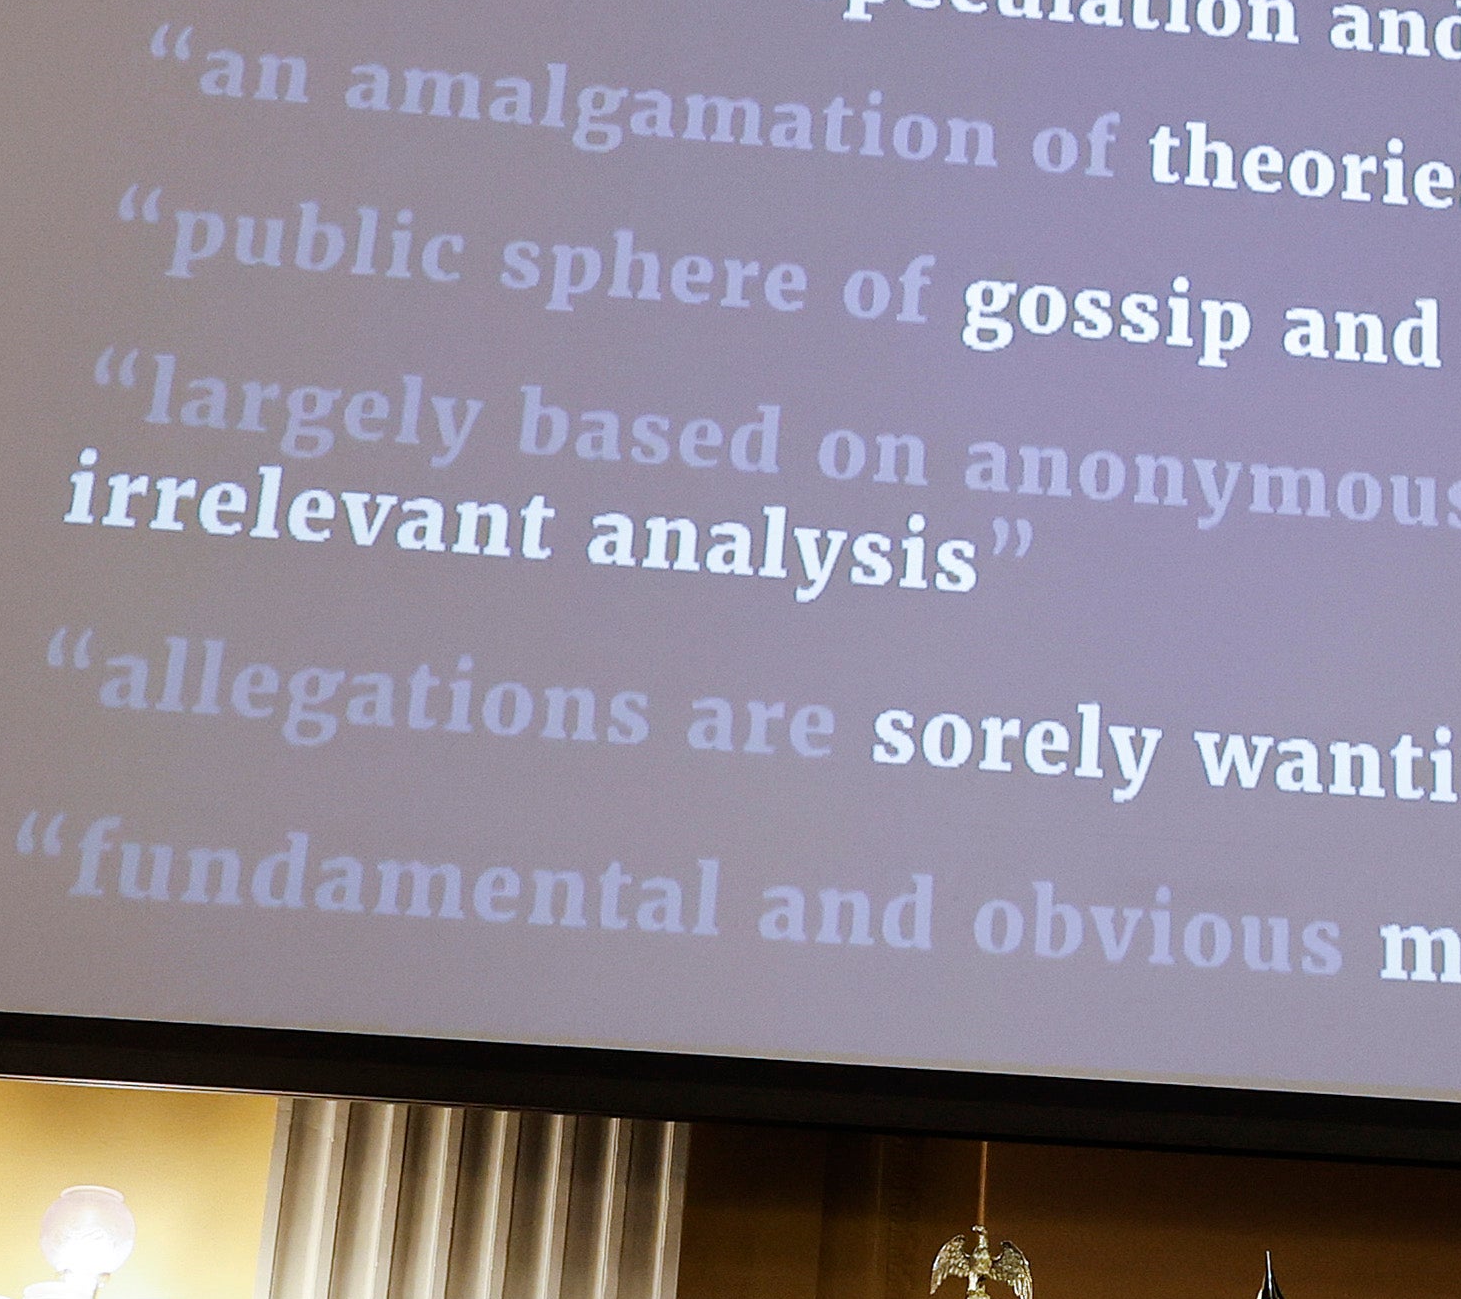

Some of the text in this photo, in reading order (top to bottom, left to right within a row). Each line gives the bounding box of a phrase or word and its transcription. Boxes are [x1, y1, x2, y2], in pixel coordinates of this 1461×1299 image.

[149, 22, 308, 103] “an
[344, 61, 997, 167] amalgamation
[1032, 111, 1121, 177] of
[117, 183, 465, 282] “public
[500, 227, 808, 312] sphere
[842, 253, 936, 324] of
[961, 274, 1251, 370] gossip
[1283, 296, 1441, 369] and
[93, 347, 483, 467] “largely
[519, 384, 781, 474] based
[817, 428, 927, 486] on
[61, 444, 1033, 603] irrelevant analysis”
[46, 626, 649, 746] “allegations
[687, 696, 835, 757] are
[871, 700, 1163, 804] sorely
[15, 811, 720, 936] “fundamental
[758, 872, 934, 951] and
[973, 879, 1343, 975] obvious
